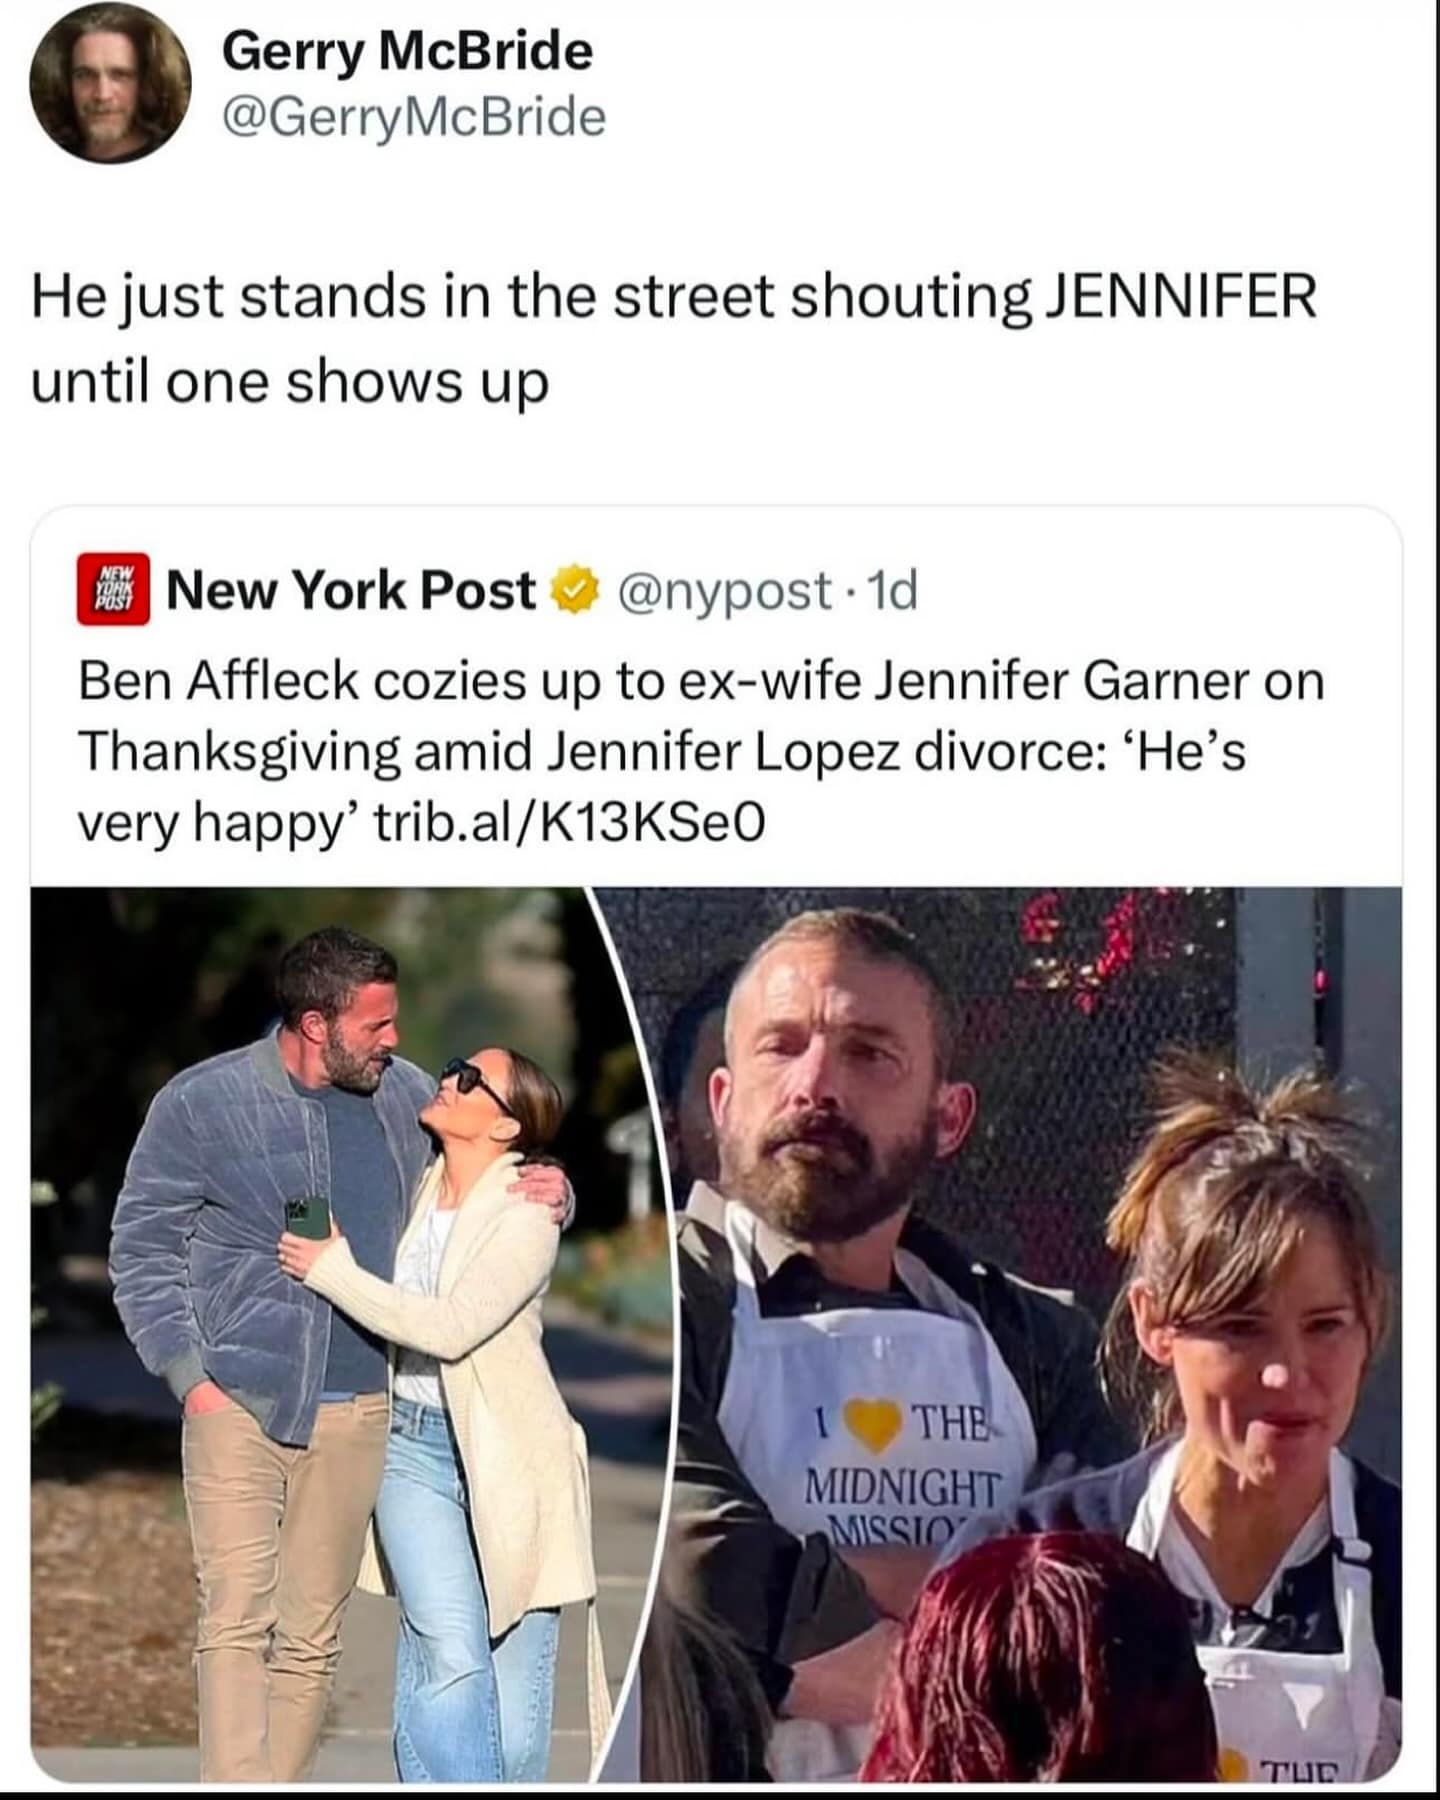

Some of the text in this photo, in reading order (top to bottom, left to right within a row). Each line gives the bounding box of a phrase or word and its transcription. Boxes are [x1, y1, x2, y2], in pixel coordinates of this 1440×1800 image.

[223, 27, 593, 81] Gerry McBride
[224, 94, 606, 147] @GerryMcBride
[34, 270, 1317, 330] He just stands in the street shouting JENNIFER
[33, 355, 549, 415] until one shows up
[100, 565, 135, 580] NEW
[168, 567, 916, 620] New York Post @nypost 1d
[95, 595, 134, 611] POST
[81, 657, 1323, 711] Ben Affleck cozies up to ex-wife Jennifer Garner on
[77, 728, 401, 783] Thanksgiving
[415, 728, 531, 771] amid
[547, 728, 742, 771] Jennifer
[757, 730, 901, 783] Lopez
[915, 728, 1105, 771] divorce:
[77, 811, 180, 852] very
[815, 1404, 990, 1442] I THE
[805, 1467, 1003, 1508] MIDNIGHT
